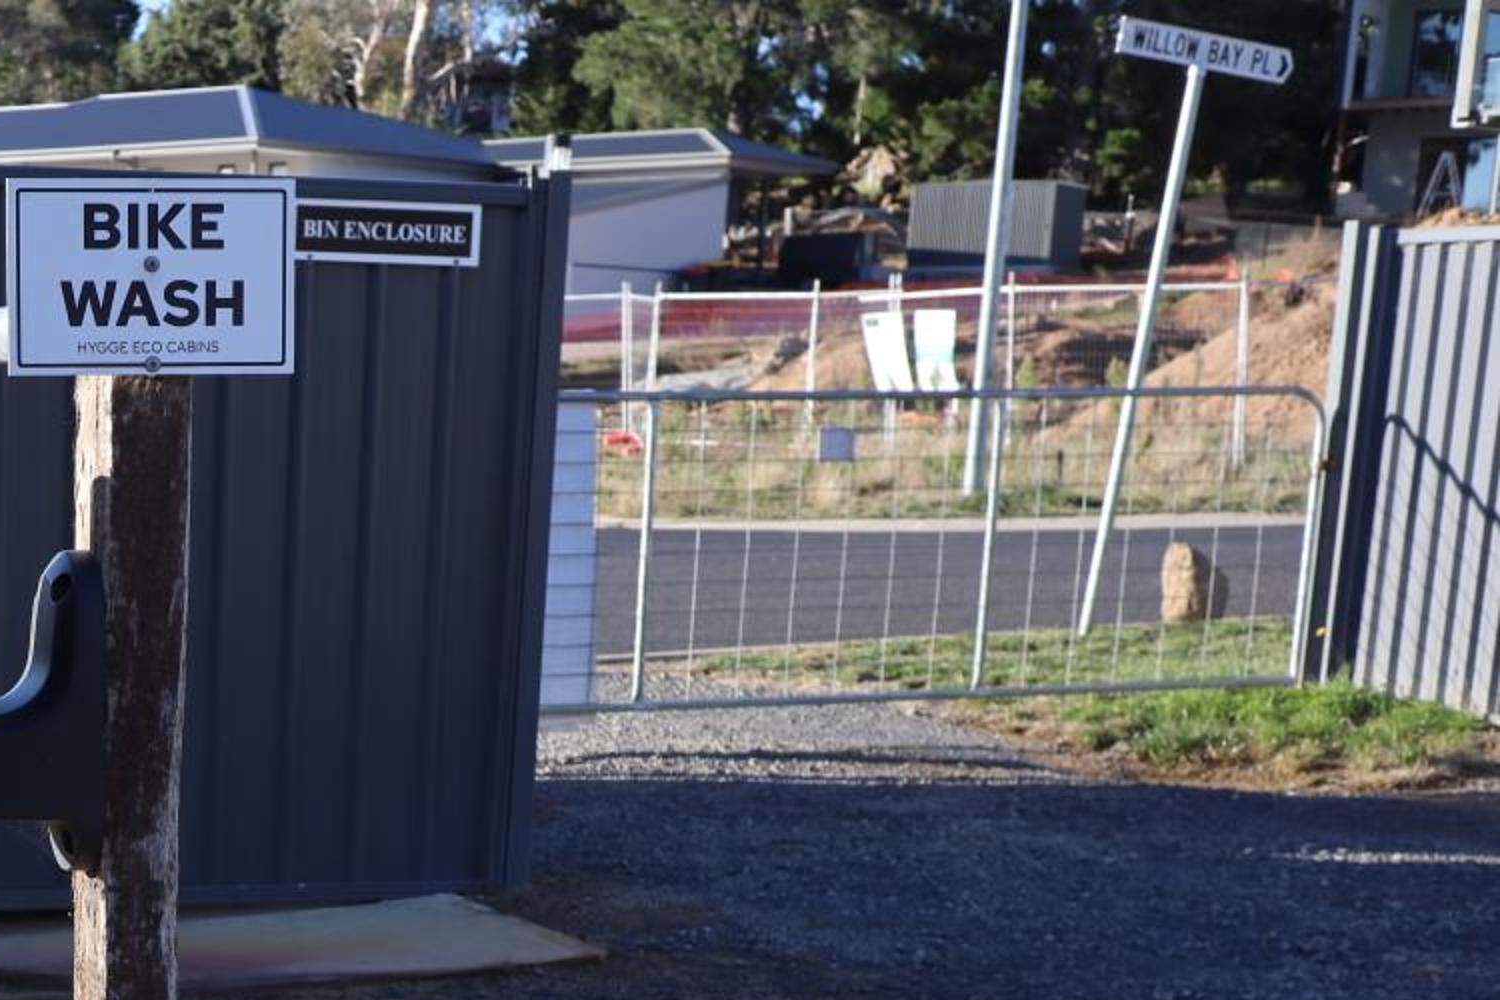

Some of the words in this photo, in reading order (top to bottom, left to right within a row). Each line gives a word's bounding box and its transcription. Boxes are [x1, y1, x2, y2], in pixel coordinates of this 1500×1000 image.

[1132, 26, 1200, 60] WILLOW
[1207, 40, 1244, 67] BAY
[1251, 49, 1271, 75] PL
[82, 202, 226, 251] BIKE
[303, 218, 339, 239] BIN
[343, 221, 467, 244] ENCLOSURE
[60, 279, 246, 328] WASH
[76, 340, 129, 354] HYGGE
[132, 340, 163, 354] ECO
[165, 340, 220, 353] CABINS
